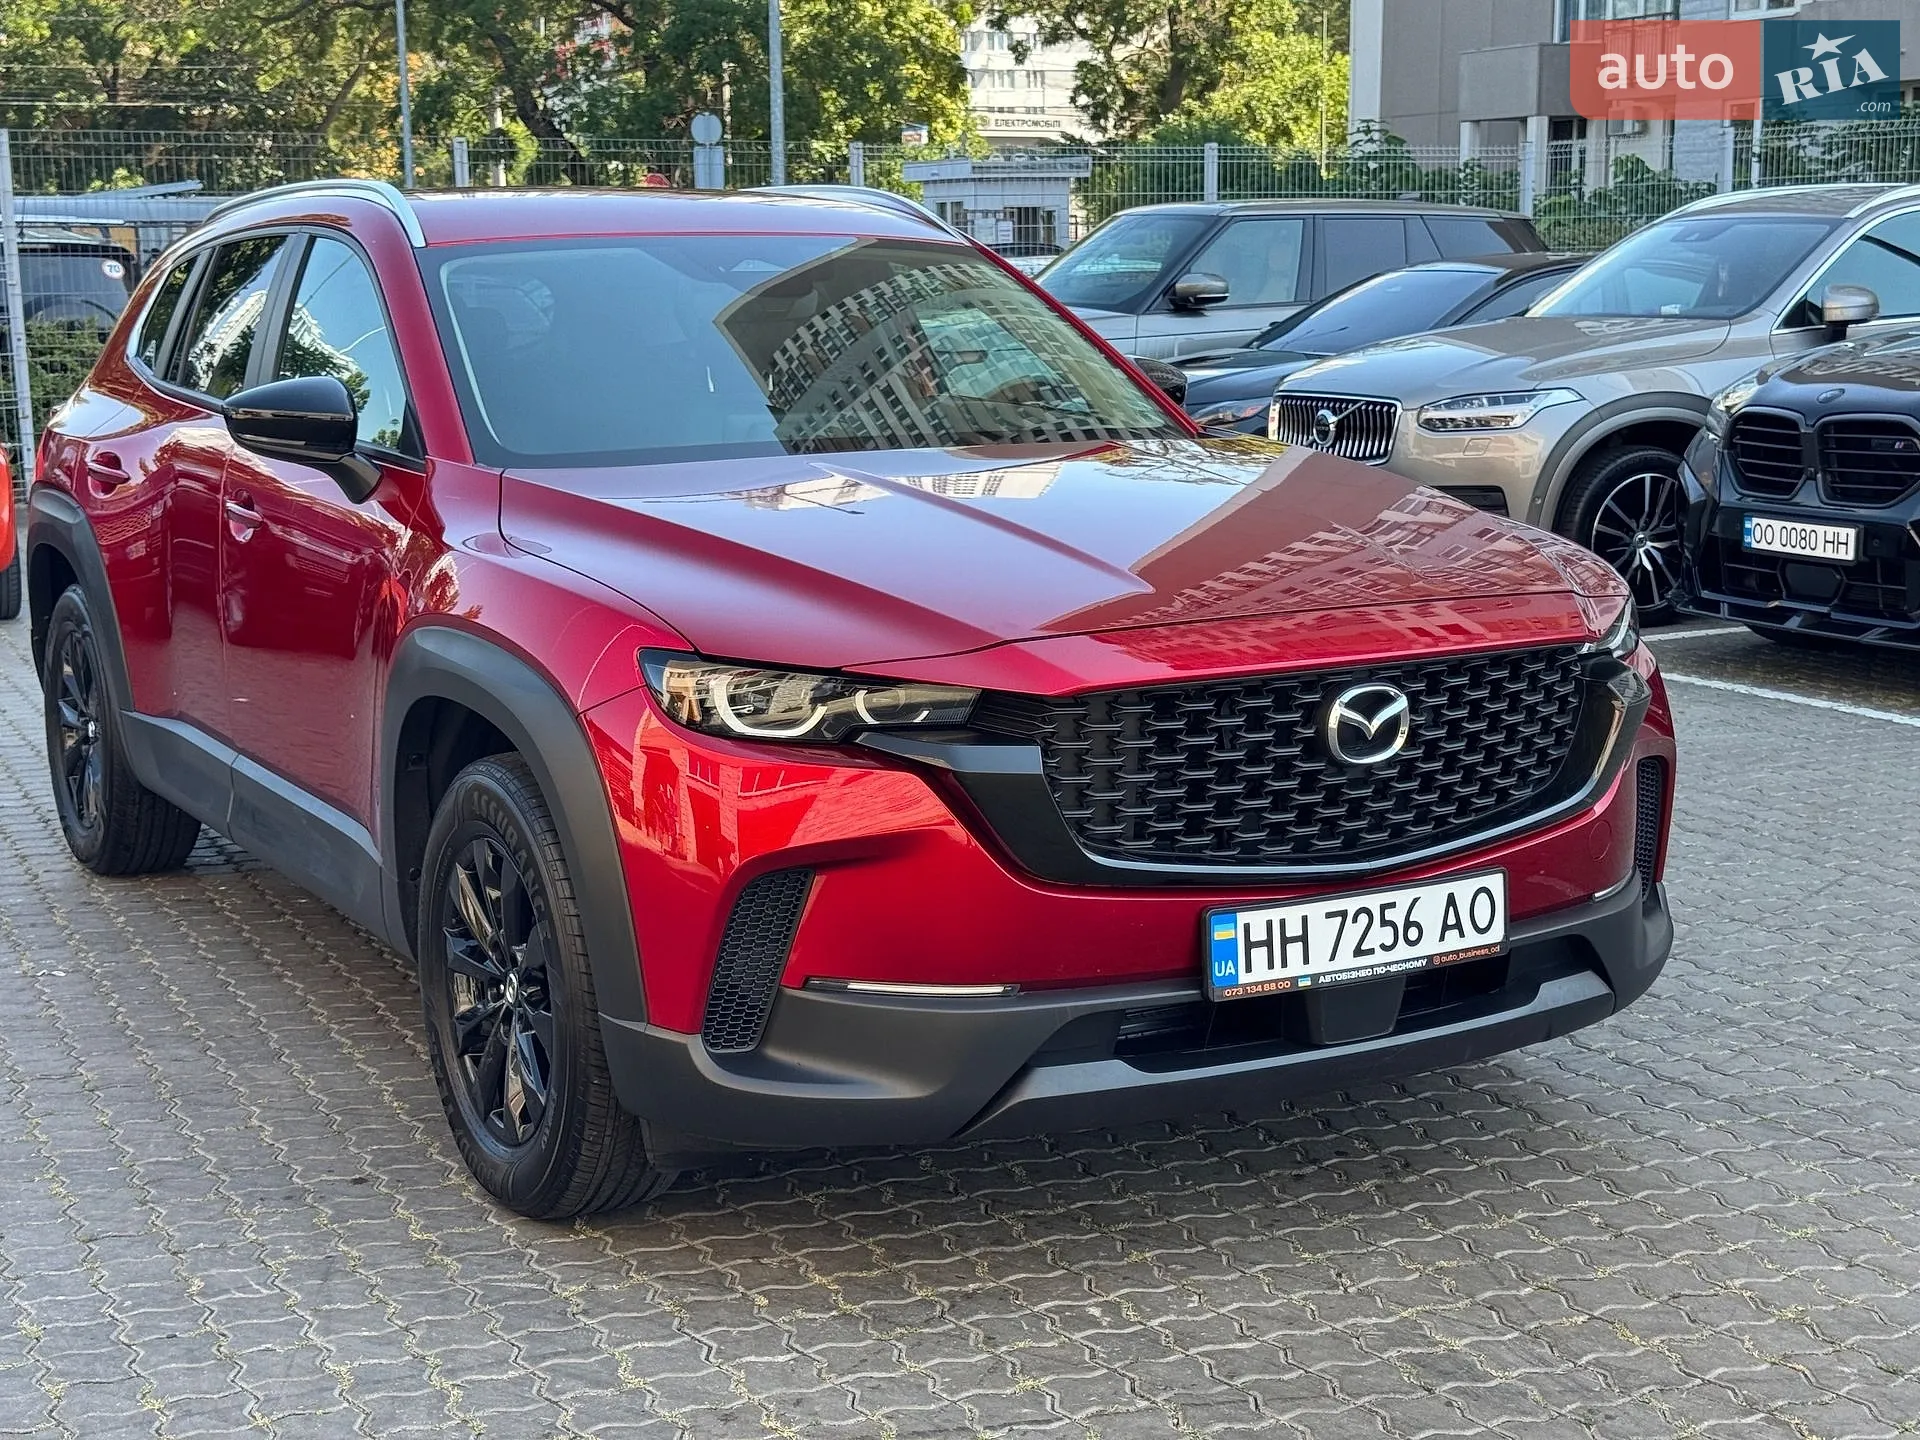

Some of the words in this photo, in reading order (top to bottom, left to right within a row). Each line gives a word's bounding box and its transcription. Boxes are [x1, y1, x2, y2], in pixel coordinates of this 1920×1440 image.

[1780, 526, 1818, 552] 0080
[1823, 530, 1849, 556] HH
[1243, 914, 1310, 974] HH
[1324, 896, 1424, 962] 7256
[1214, 959, 1236, 977] UA
